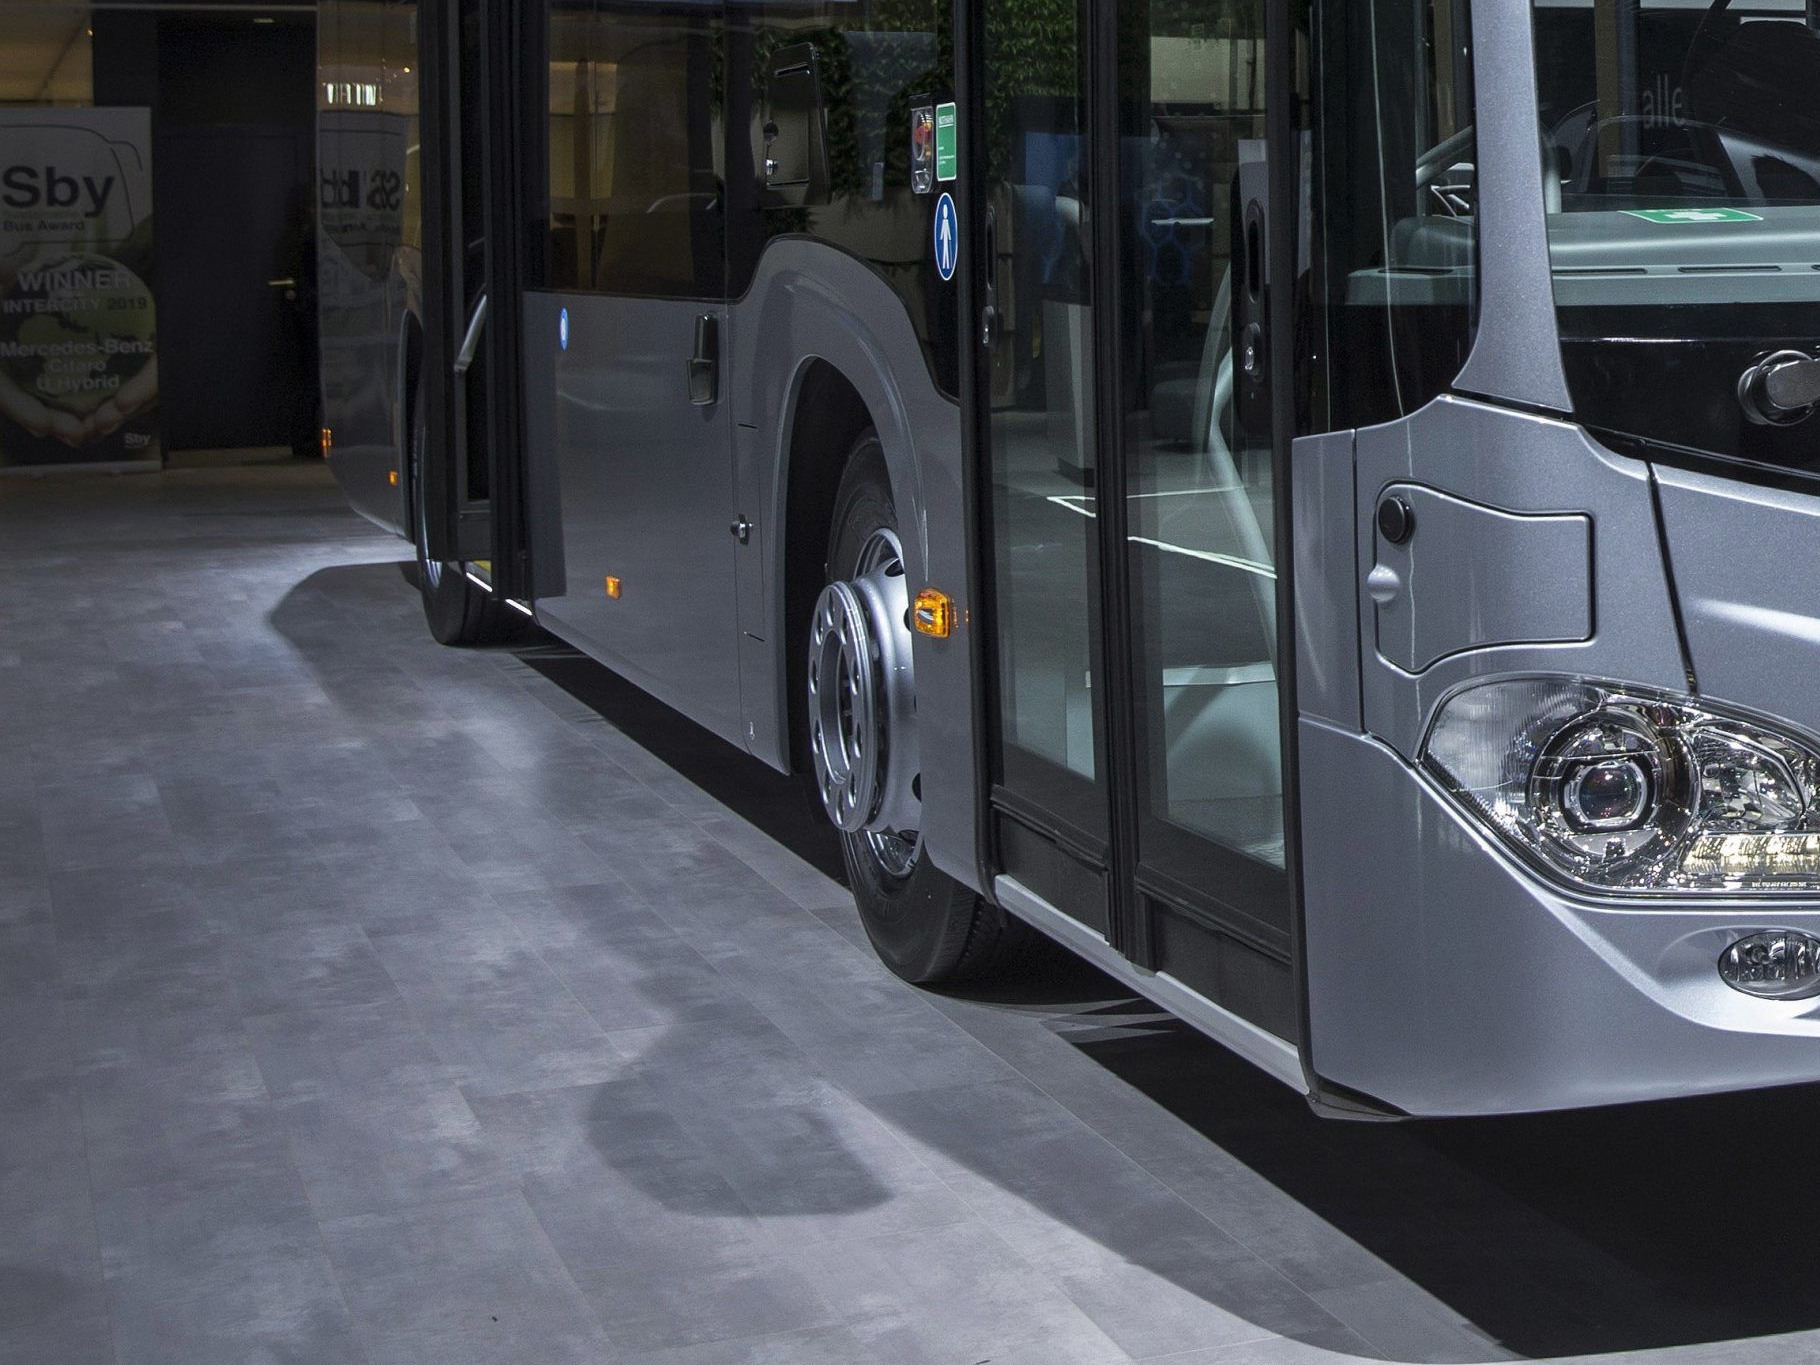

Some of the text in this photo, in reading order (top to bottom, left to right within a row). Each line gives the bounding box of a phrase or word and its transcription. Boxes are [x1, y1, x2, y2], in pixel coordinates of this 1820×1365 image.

[2, 165, 115, 218] Sby
[38, 219, 84, 231] Award
[17, 268, 132, 292] WINNER
[3, 295, 149, 314] INTERCITY 2019
